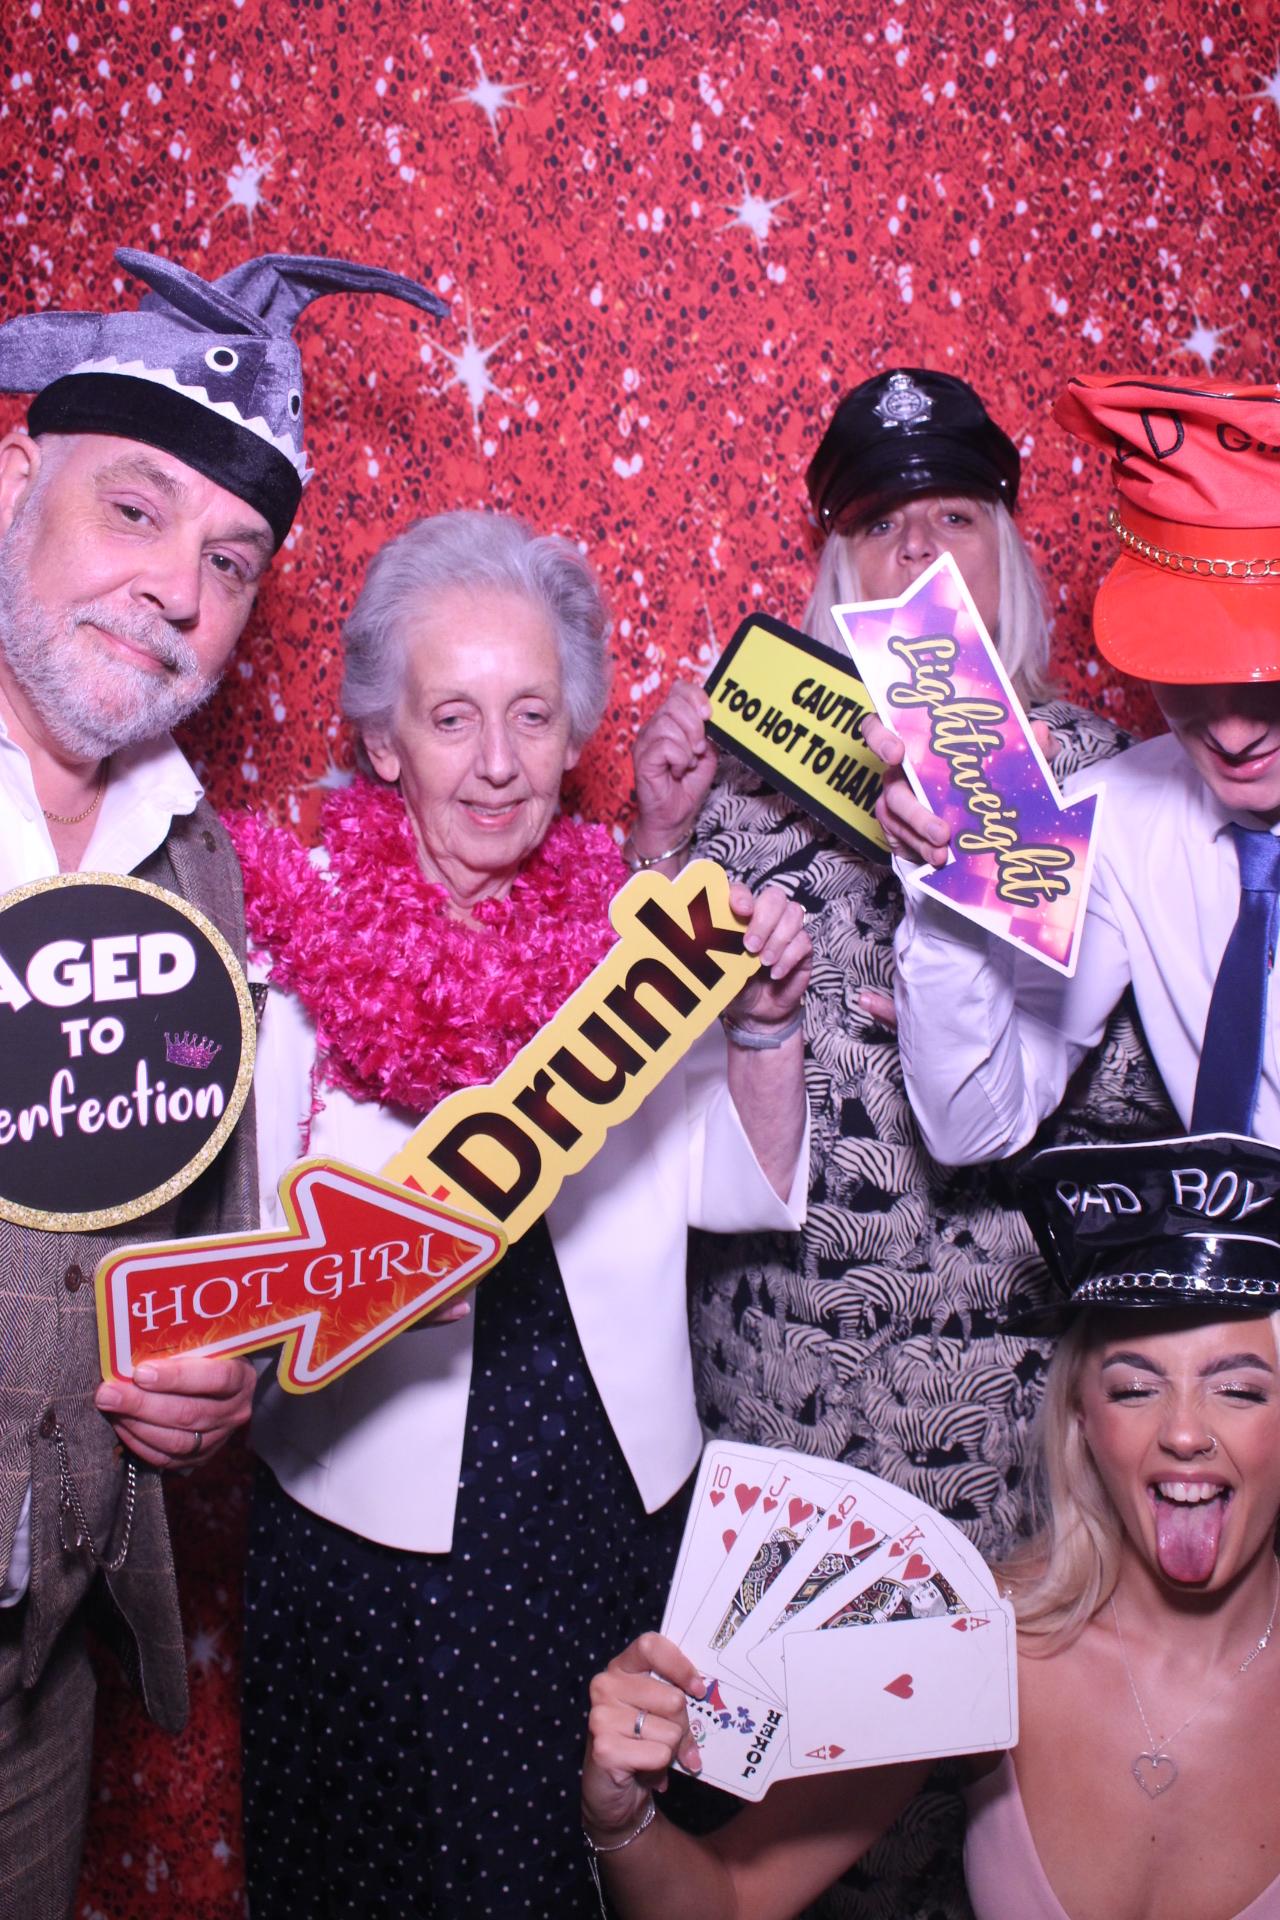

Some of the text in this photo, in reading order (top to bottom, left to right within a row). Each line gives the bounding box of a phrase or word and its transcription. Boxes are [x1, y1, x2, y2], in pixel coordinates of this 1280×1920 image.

[716, 678, 885, 819] TOO HOT TO HAN
[888, 635, 1075, 907] Lightweight
[61, 1016, 125, 1058] TO
[427, 886, 746, 1222] Drunk
[0, 1060, 224, 1145] erfection
[1171, 1168, 1275, 1222] BOY
[132, 1233, 448, 1332] HOT GIRL
[712, 1464, 732, 1489] 10
[769, 1475, 791, 1497] J
[838, 1495, 857, 1519] Q
[903, 1525, 926, 1551] K
[970, 1616, 991, 1631] A
[740, 1709, 784, 1778] JOKER
[804, 1745, 827, 1761] A
